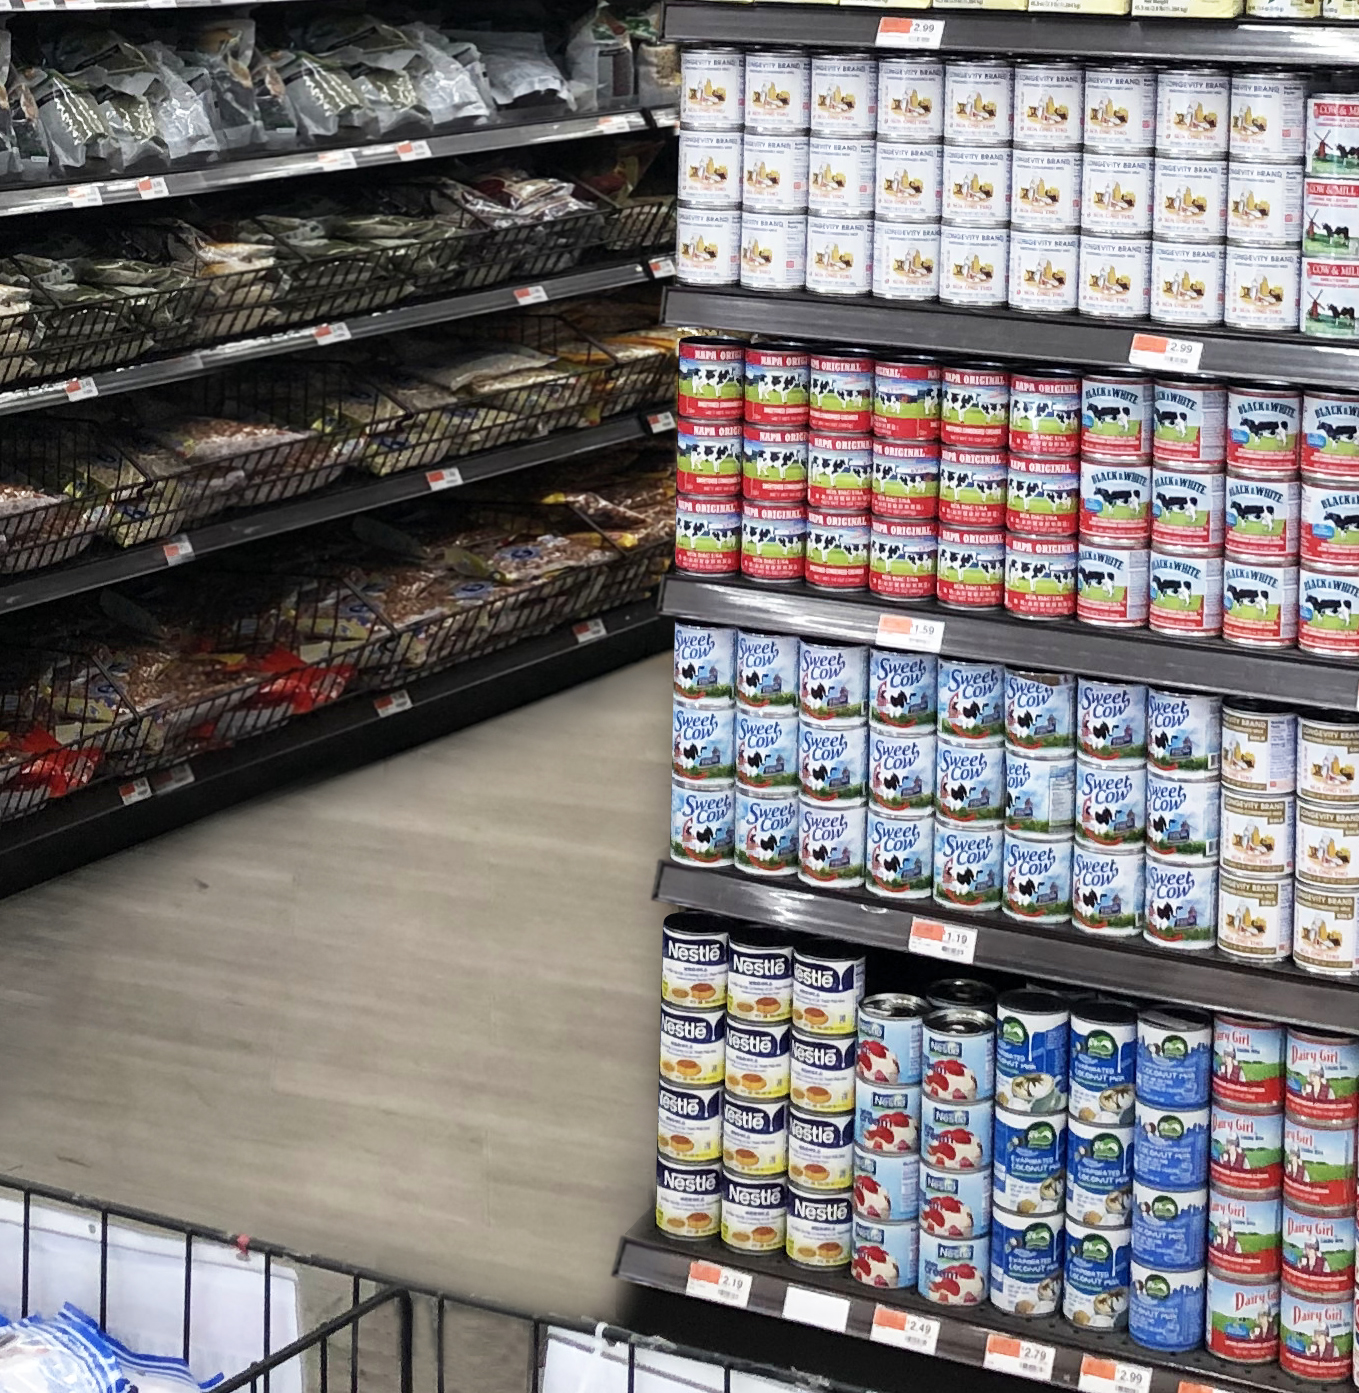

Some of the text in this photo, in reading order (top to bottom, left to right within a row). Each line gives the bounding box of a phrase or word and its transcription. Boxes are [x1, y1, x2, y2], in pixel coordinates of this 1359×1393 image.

[1319, 105, 1337, 115] COW
[1339, 106, 1347, 115] &
[1312, 264, 1330, 274] COW
[1331, 265, 1338, 275] &
[802, 650, 845, 672] Sweet
[877, 657, 926, 680] Sweet
[811, 664, 842, 680] Cow
[890, 672, 922, 688] Cow
[1082, 687, 1130, 710] Sweet
[1093, 702, 1126, 719] Cow
[674, 709, 718, 732] Sweet
[684, 725, 714, 741] Cow
[1083, 773, 1132, 796] Sweet
[1095, 788, 1128, 804] Cow
[1008, 845, 1055, 868] Sweet
[1019, 860, 1052, 876] Cow
[1292, 1045, 1338, 1065] Dairy Girl
[1287, 1218, 1333, 1237] Dairy Girl
[1293, 1305, 1342, 1323] Dairy Girl
